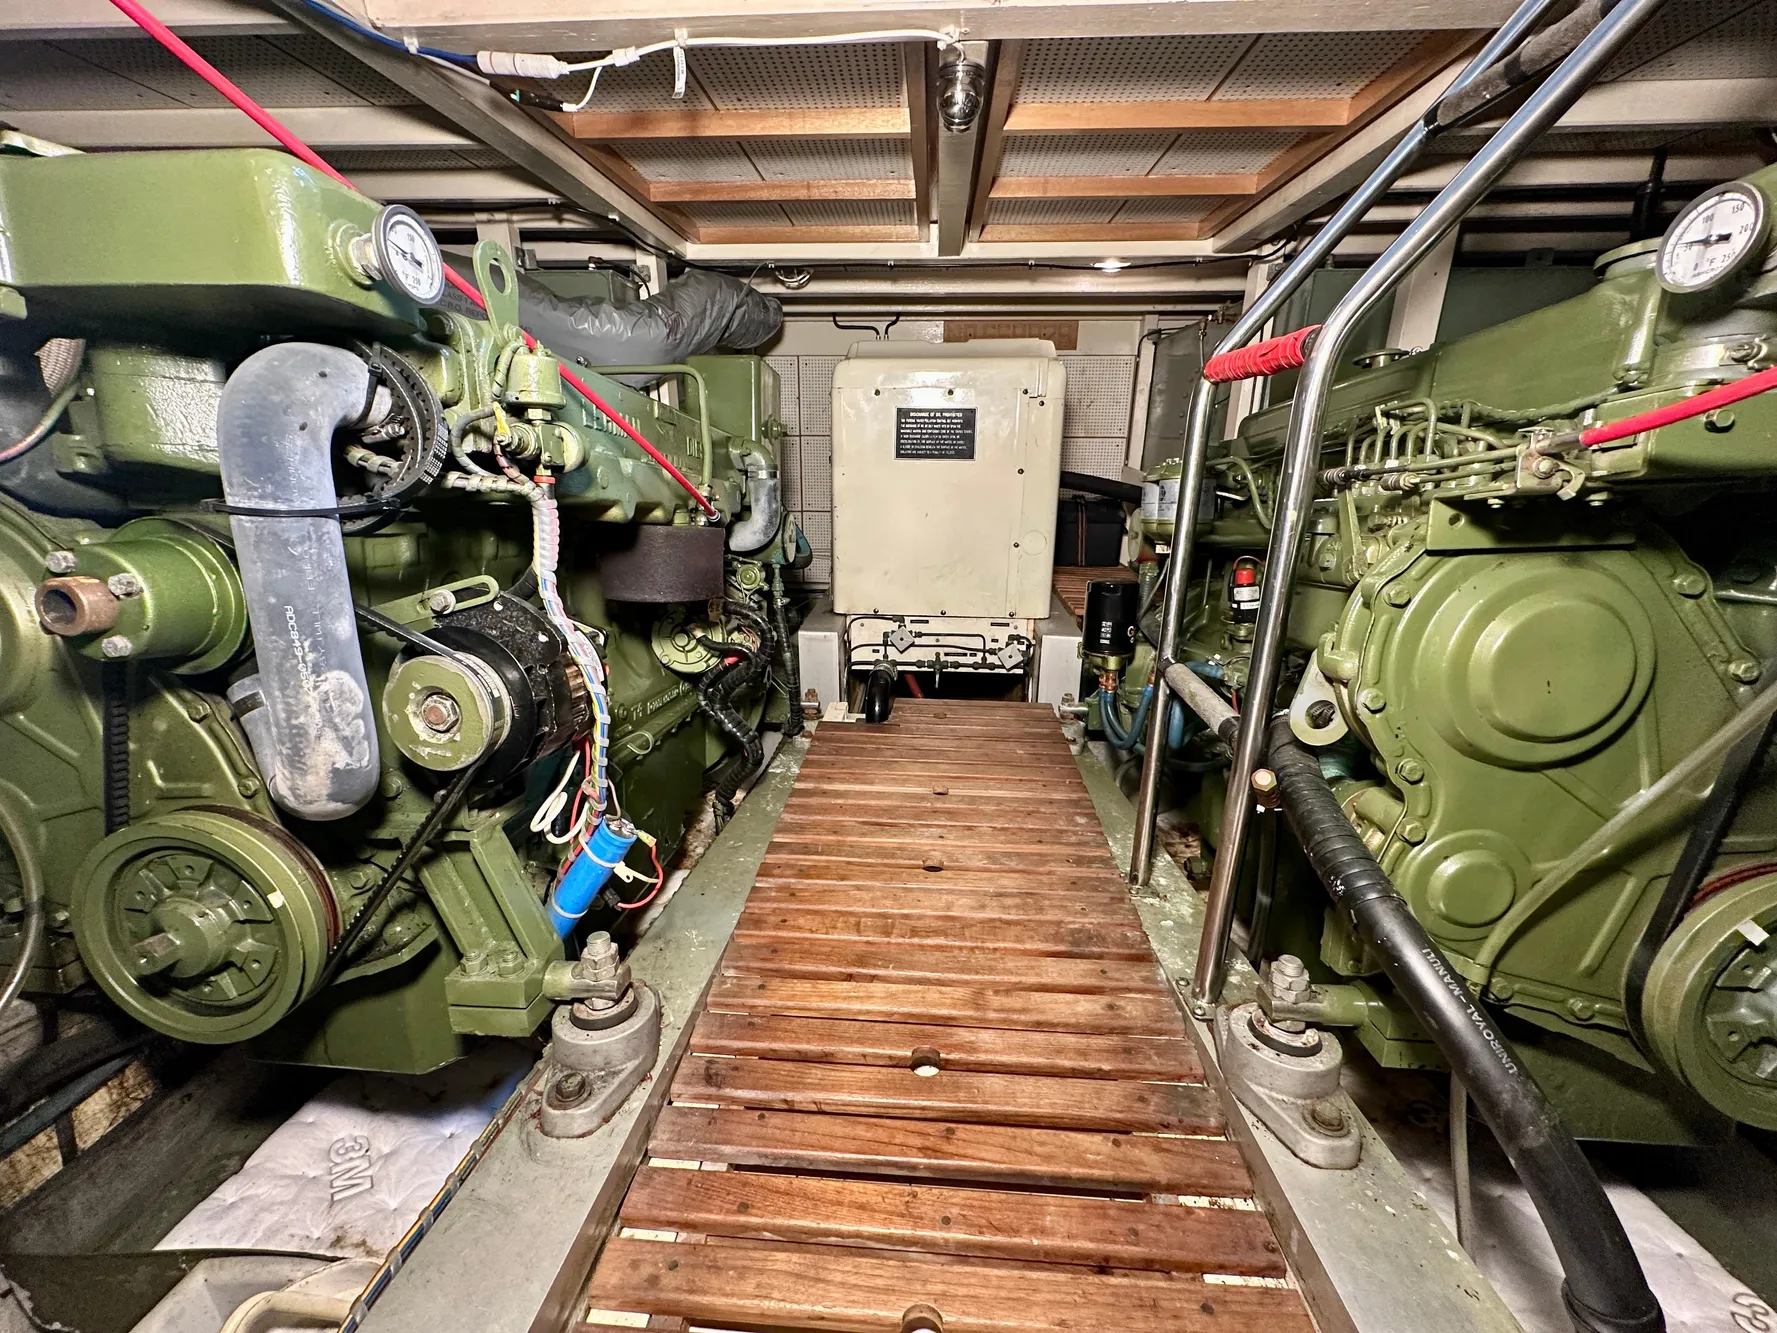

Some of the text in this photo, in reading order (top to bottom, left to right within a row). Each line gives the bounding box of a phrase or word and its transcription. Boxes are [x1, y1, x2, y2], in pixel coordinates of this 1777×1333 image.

[1731, 201, 1745, 214] 150
[1702, 213, 1714, 224] 100
[328, 1134, 374, 1203] 3M
